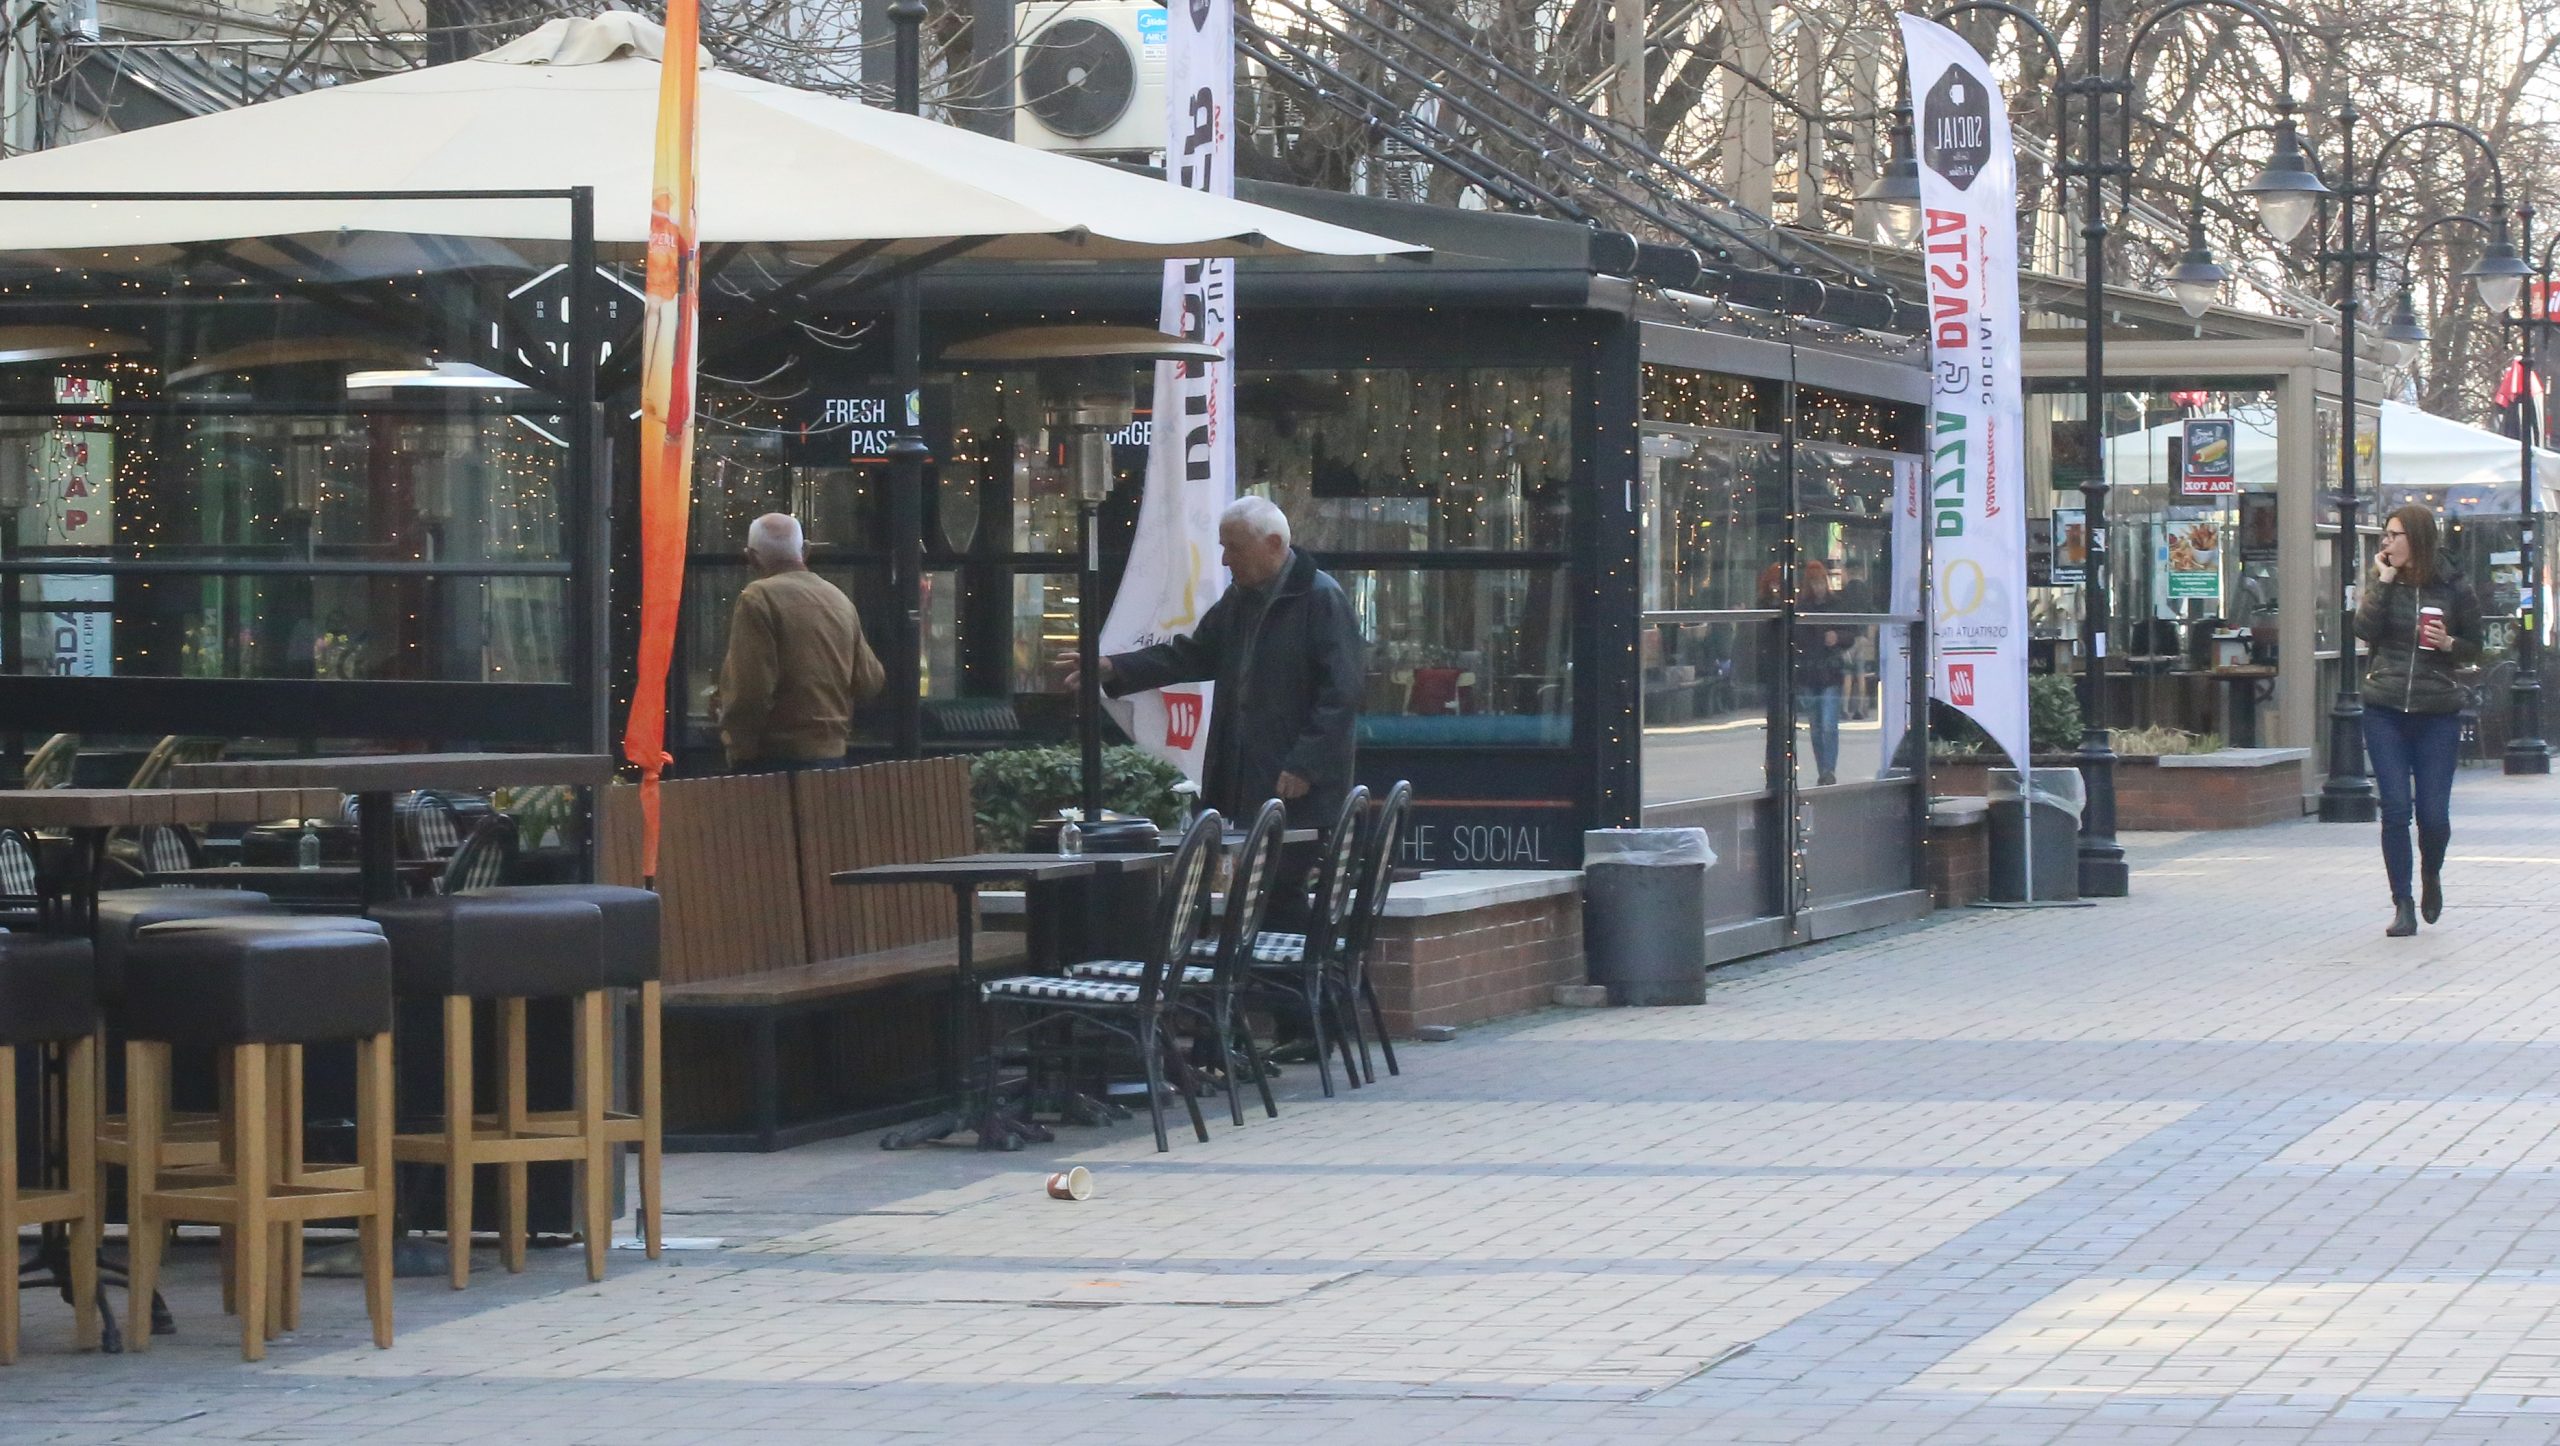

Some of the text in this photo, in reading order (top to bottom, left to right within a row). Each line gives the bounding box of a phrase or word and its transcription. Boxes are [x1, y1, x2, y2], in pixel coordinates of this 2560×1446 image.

[825, 399, 886, 423] FRESH
[851, 430, 896, 454] PAS
[2184, 482, 2233, 491] ХОТ ДОГ
[1402, 825, 1550, 862] HE SOCIAL
